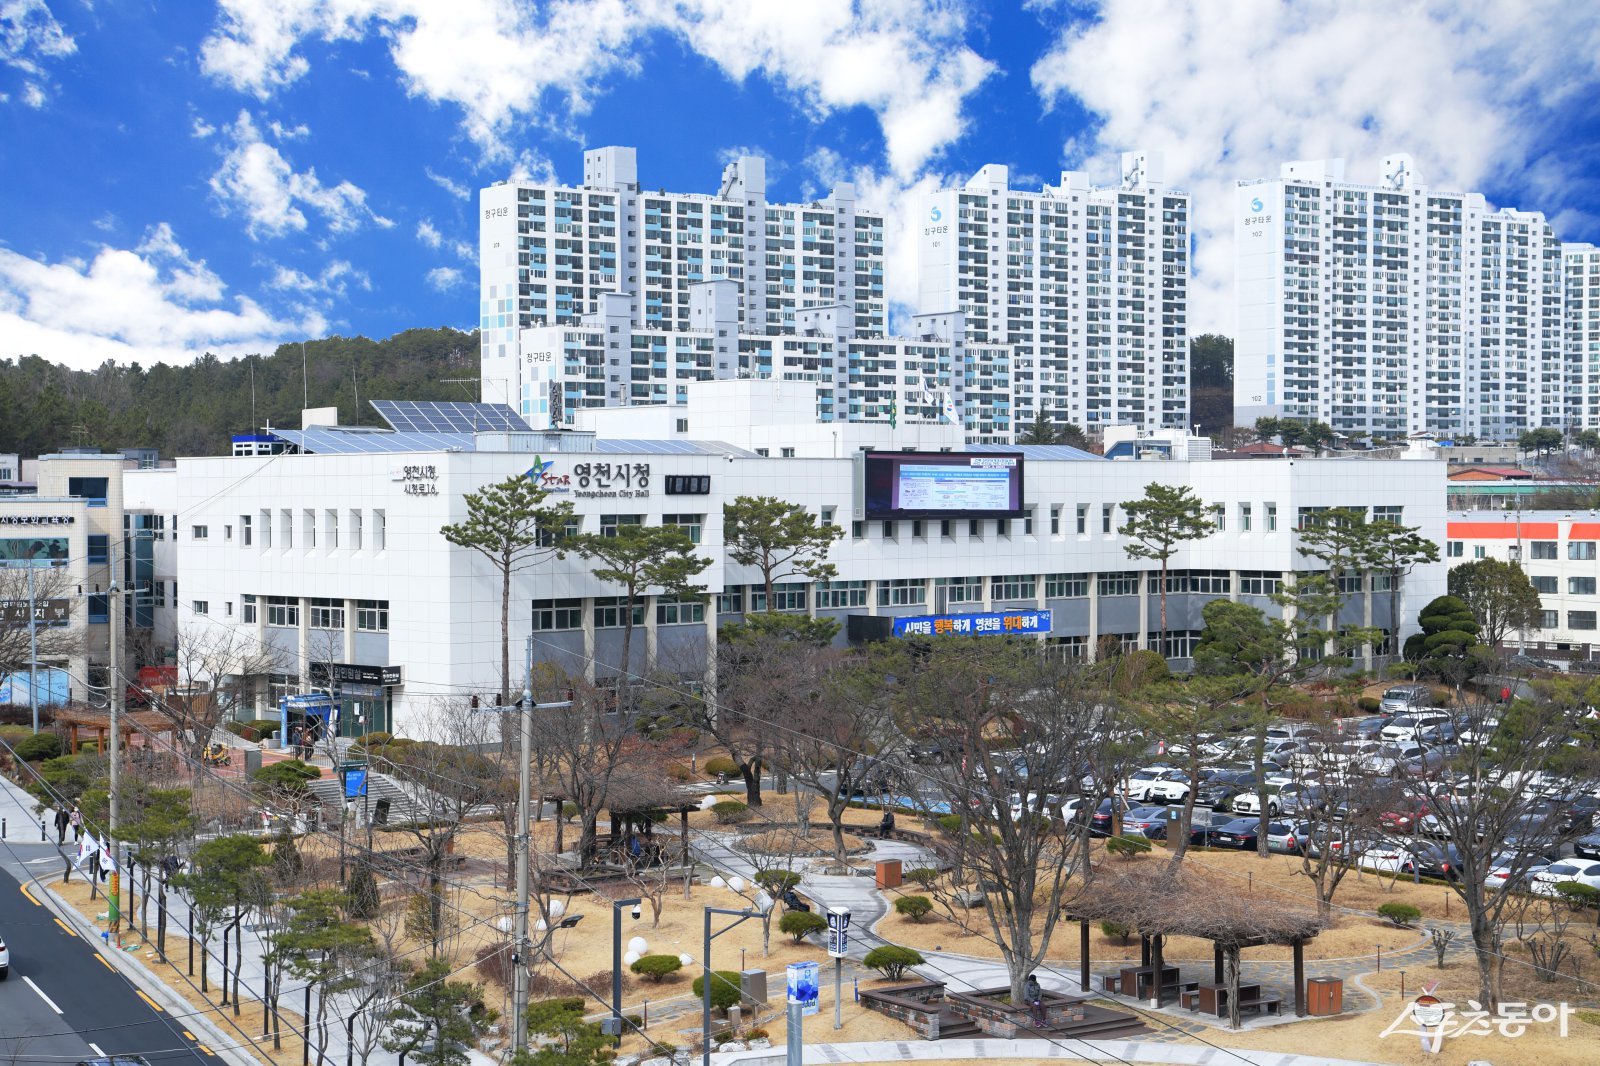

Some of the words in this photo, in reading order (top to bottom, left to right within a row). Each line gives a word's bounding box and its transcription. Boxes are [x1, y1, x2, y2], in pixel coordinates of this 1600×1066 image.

[526, 351, 552, 364] 청구타운
[403, 464, 437, 480] 영천시청
[573, 462, 650, 489] 영천시청
[573, 489, 617, 499] Yeongcheon
[618, 489, 634, 500] City
[635, 489, 650, 499] Hall
[904, 621, 931, 635] 시민을
[934, 618, 971, 634] 행복하게
[975, 617, 1001, 632] 영천을
[1003, 614, 1039, 631] 위대하게
